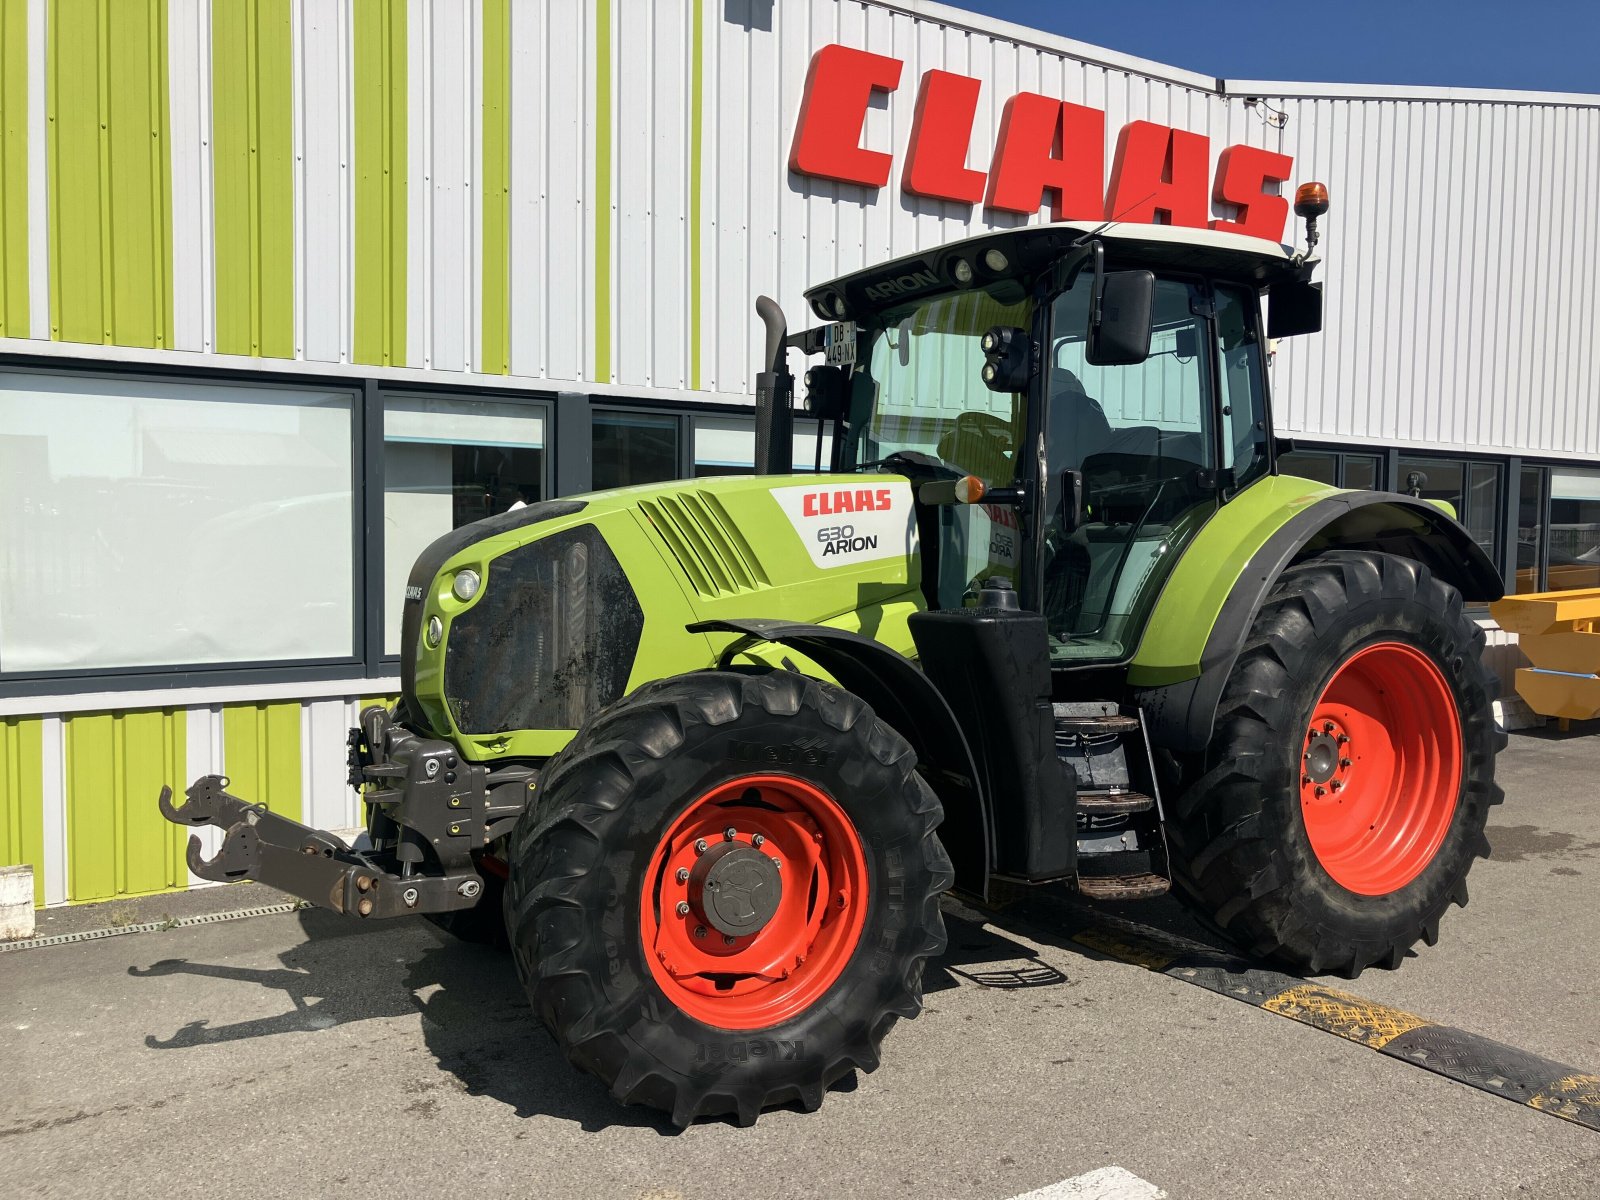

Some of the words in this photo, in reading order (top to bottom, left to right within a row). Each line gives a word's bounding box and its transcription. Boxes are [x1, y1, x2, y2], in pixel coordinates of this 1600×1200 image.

[789, 44, 1293, 243] CLAAS
[865, 269, 940, 301] ARION
[803, 489, 891, 517] CLAAS
[817, 525, 854, 543] 630
[822, 535, 878, 557] ARION
[695, 1039, 806, 1062] Kleber
